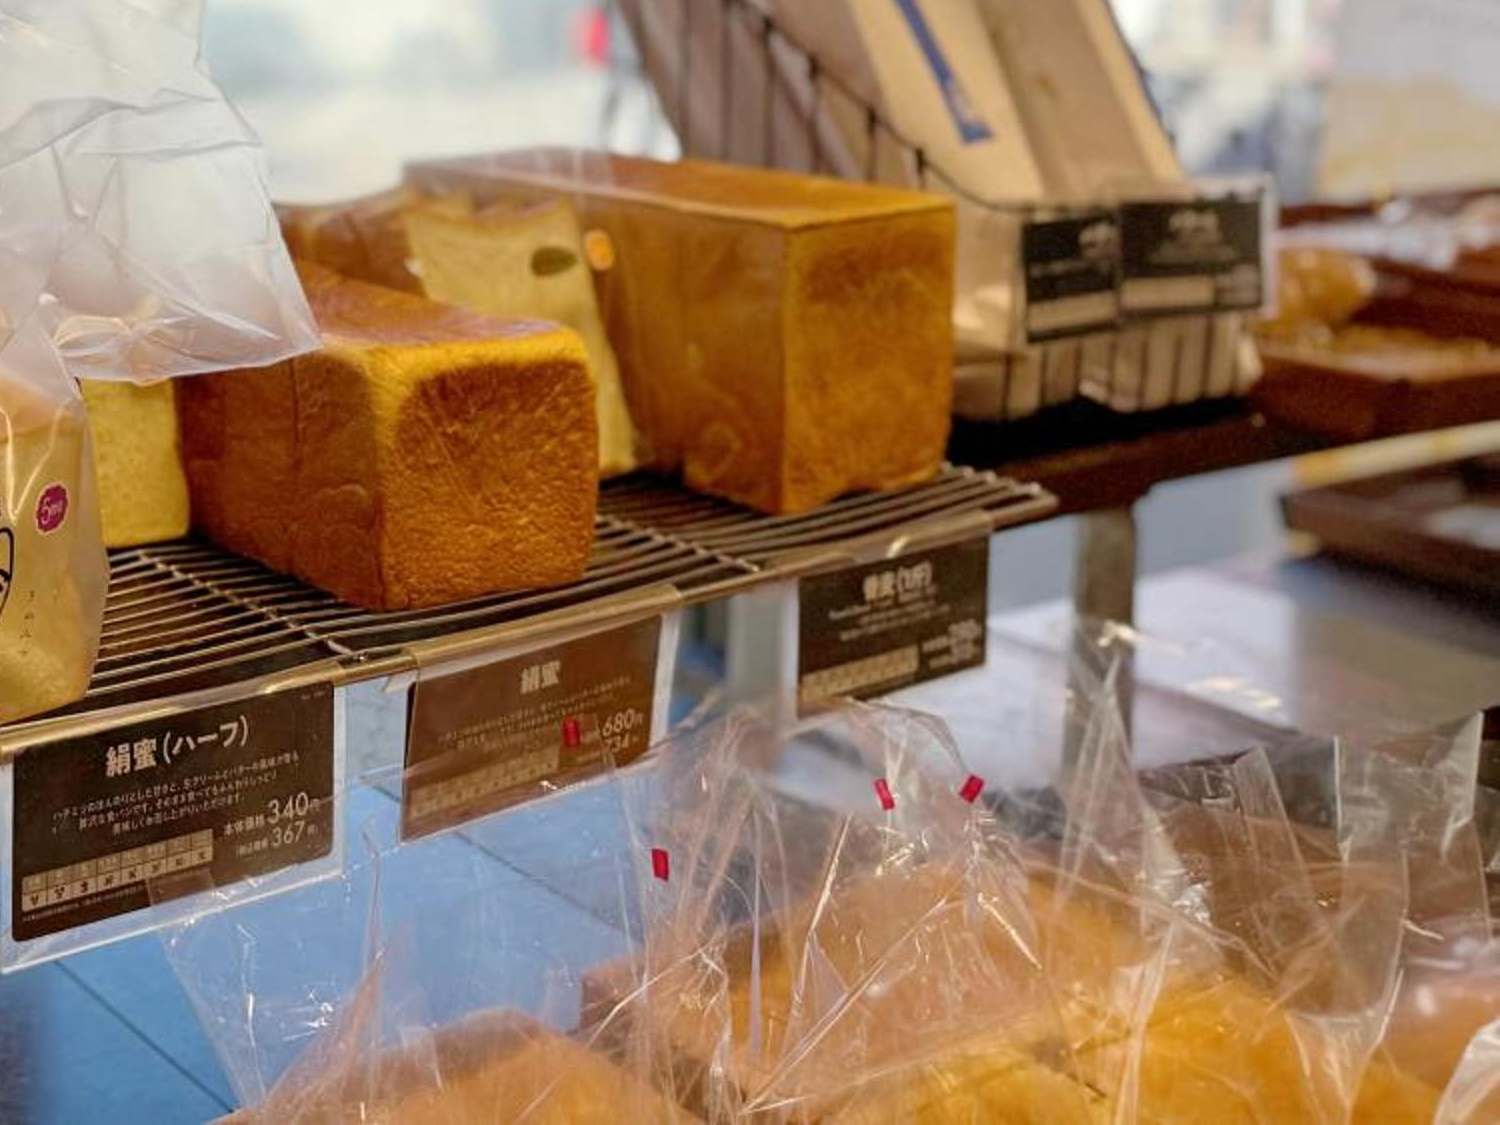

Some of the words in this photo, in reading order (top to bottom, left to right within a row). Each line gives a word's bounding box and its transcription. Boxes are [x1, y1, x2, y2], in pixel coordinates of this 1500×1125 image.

[105, 715, 250, 777] 絹蜜(ハーフ)
